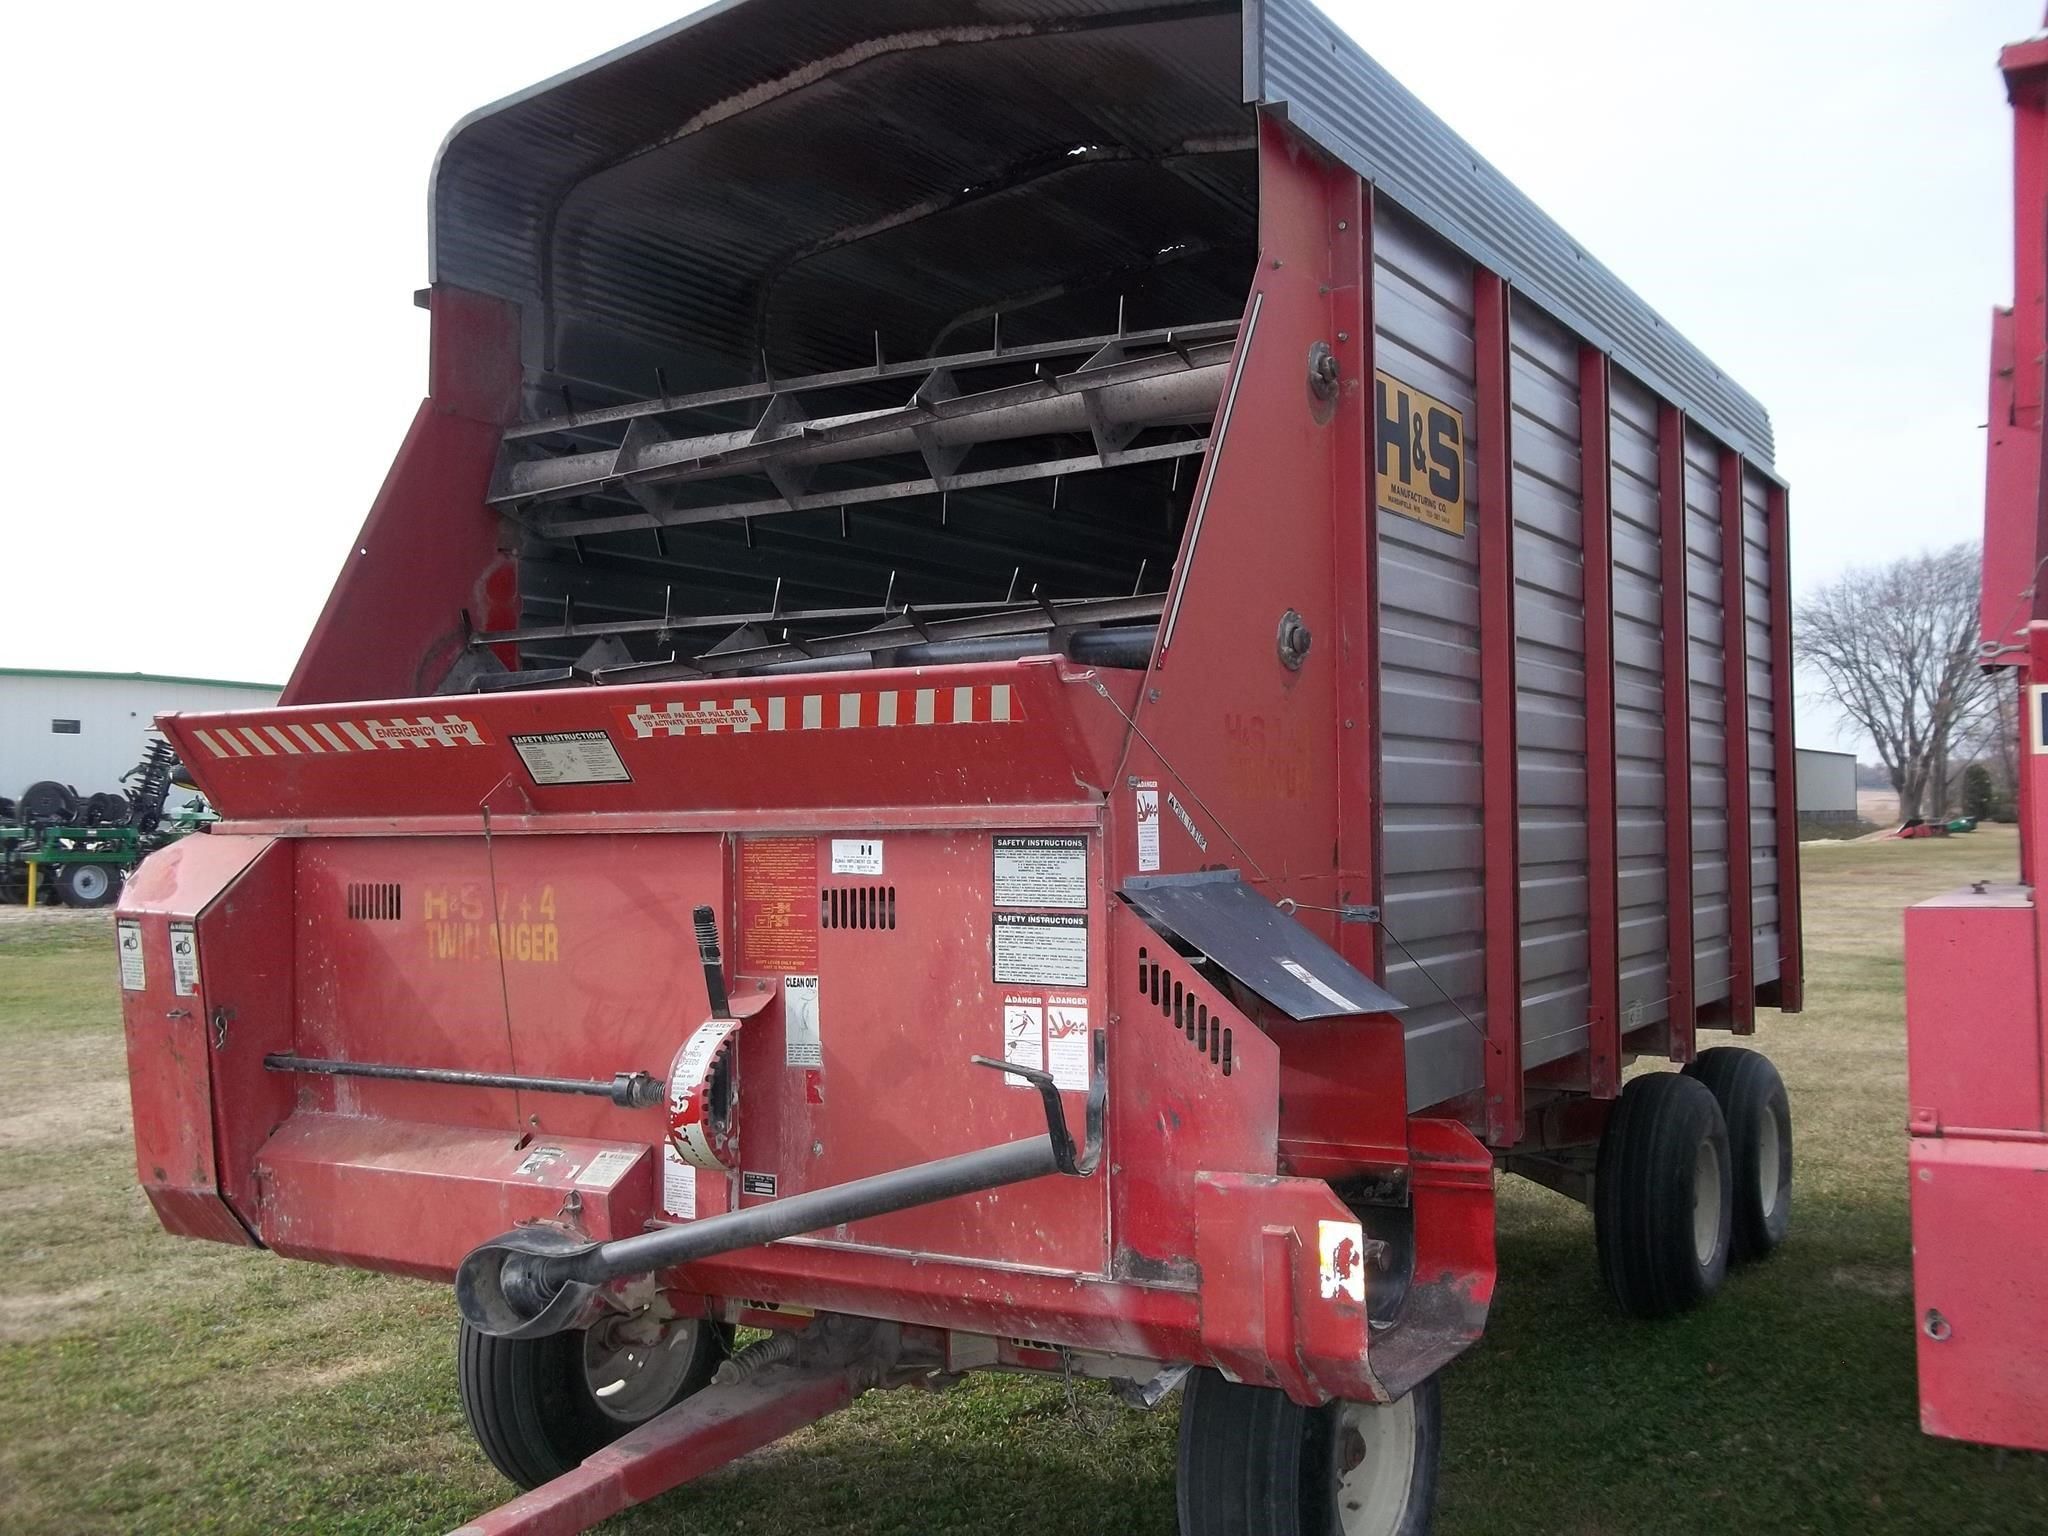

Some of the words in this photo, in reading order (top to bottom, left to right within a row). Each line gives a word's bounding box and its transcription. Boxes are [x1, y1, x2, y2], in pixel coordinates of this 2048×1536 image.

[1376, 379, 1460, 503] H&S
[1391, 484, 1437, 510] MANUFACTURING
[376, 726, 436, 738] EMERGENCY
[442, 724, 469, 734] STOP
[512, 735, 543, 744] SAFETY
[545, 731, 606, 742] INSTRUCTIONS
[1028, 839, 1083, 847] INSTRUCTIONS
[998, 915, 1026, 923] SAFETY
[1028, 916, 1084, 925] INSTRUCTIONS
[786, 977, 804, 988] CLEAN
[806, 978, 817, 988] OUT
[1056, 997, 1087, 1005] DANGER
